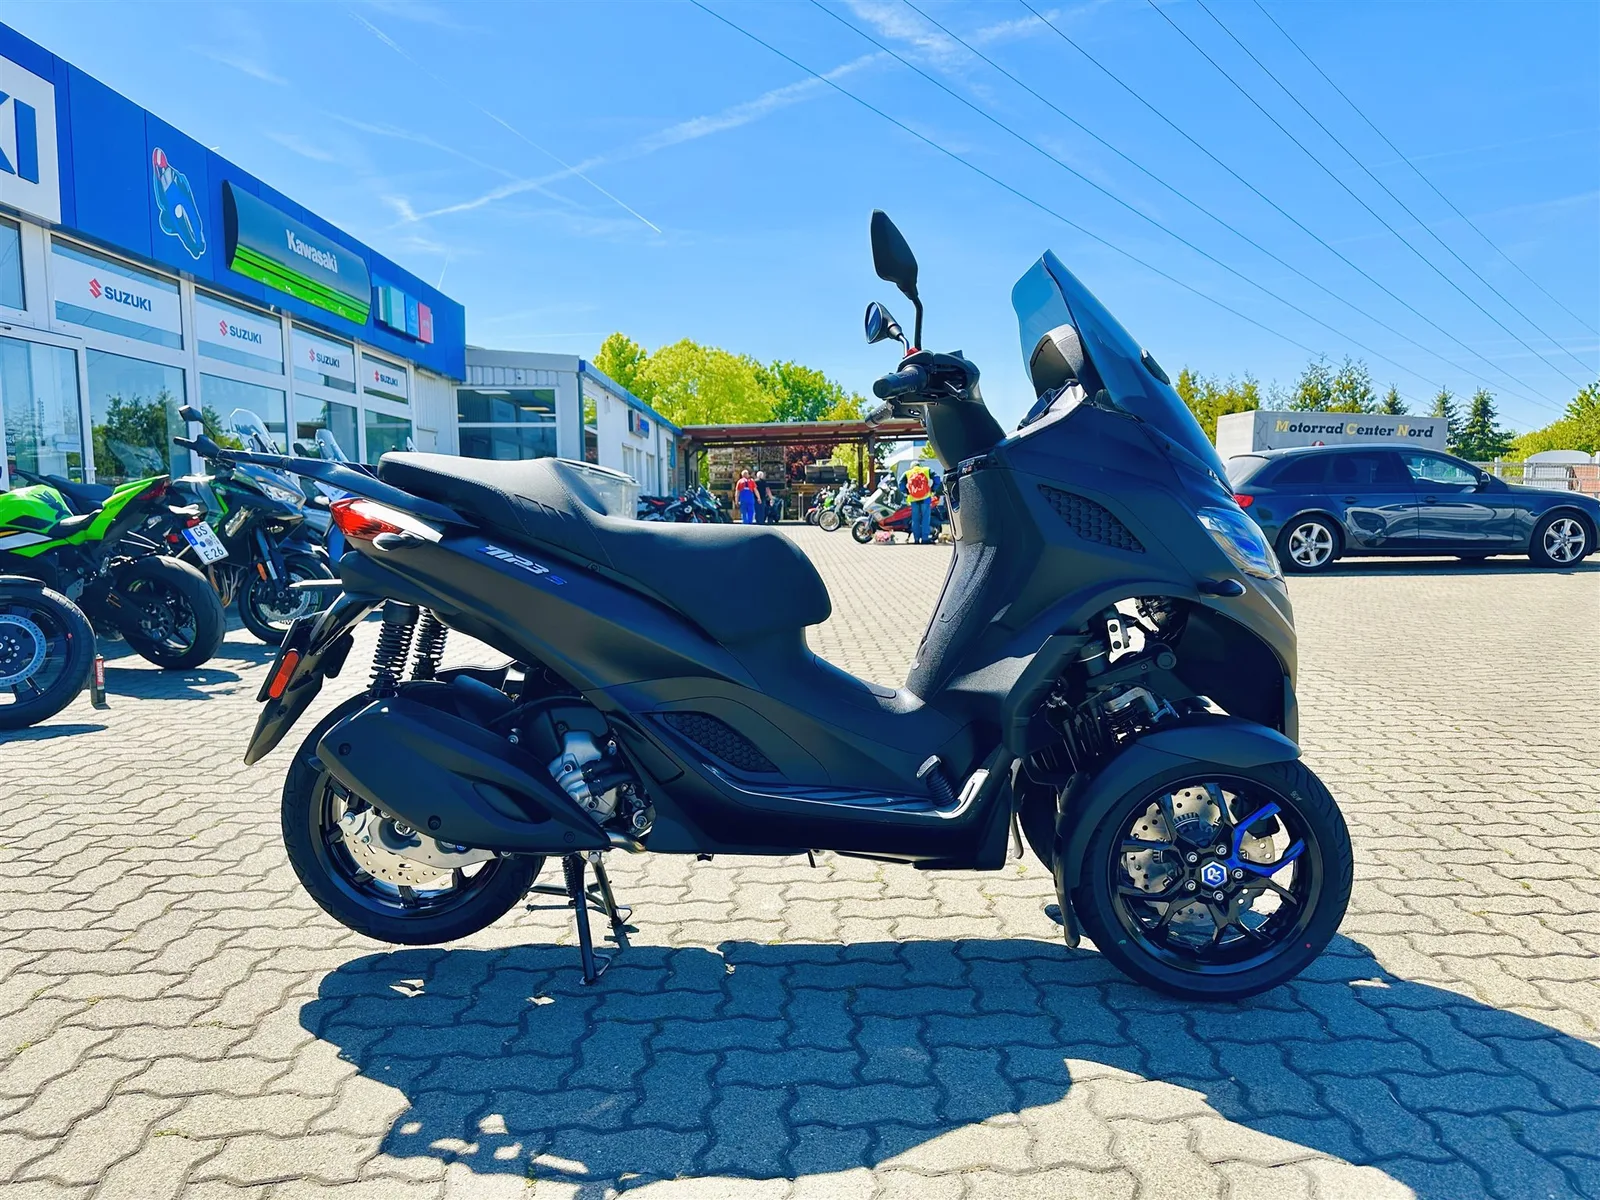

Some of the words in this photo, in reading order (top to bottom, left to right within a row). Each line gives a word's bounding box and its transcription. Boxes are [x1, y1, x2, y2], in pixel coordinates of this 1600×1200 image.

[285, 229, 338, 273] Kawasaki
[104, 286, 152, 312] SUZUKI
[229, 325, 262, 345] SUZUKI
[316, 352, 340, 368] SUZUKI
[380, 373, 399, 387] SUZUKI
[1274, 420, 1344, 434] Motorrad
[1346, 423, 1394, 437] Center
[1396, 424, 1434, 438] Nord
[193, 525, 208, 537] GS
[96, 660, 104, 683] MOTUL
